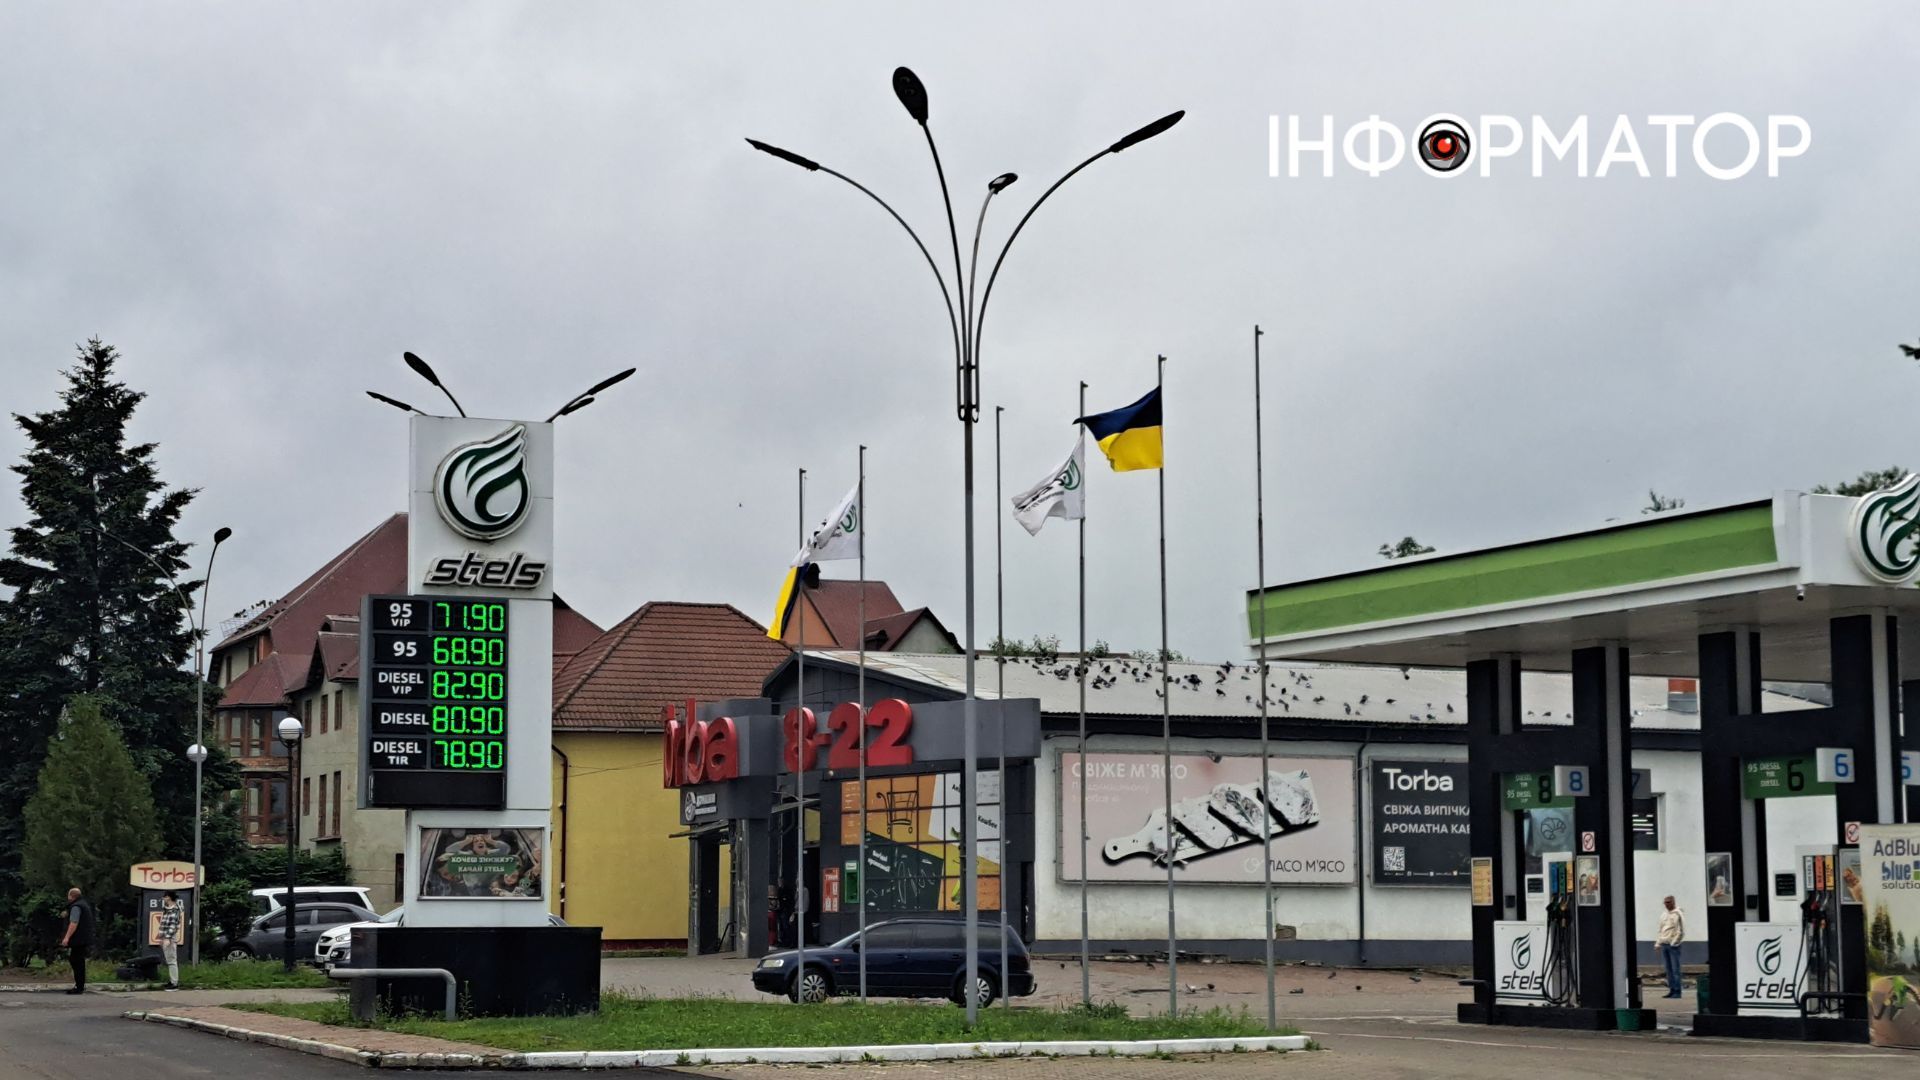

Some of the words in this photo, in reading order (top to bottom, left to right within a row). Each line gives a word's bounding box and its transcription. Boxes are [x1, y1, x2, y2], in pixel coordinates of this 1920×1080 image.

[426, 553, 548, 588] stels
[389, 603, 412, 617] 95
[435, 603, 505, 631] 71.90
[391, 618, 411, 627] VIP
[393, 642, 417, 656] 95
[433, 637, 504, 666] 68.90
[378, 672, 424, 684] DIESEL
[432, 671, 504, 700] 82.90
[392, 686, 412, 694] VIP
[380, 712, 429, 725] DIESEL
[432, 706, 503, 734] 80.90
[784, 699, 913, 773] 8-22
[373, 741, 422, 754] DIESEL
[435, 740, 503, 768] 78.90
[388, 756, 408, 765] TIR
[1835, 753, 1849, 777] 6
[1071, 762, 1126, 779] СВІЖЕ
[1382, 768, 1454, 791] Torba
[1787, 759, 1804, 791] 6
[1538, 775, 1552, 803] 8
[1569, 771, 1584, 792] 8
[1384, 805, 1421, 815] СВІЖА
[1384, 823, 1449, 834] АРОМАТНА
[1873, 838, 1920, 856] AdBlu
[137, 867, 196, 884] Torba
[1306, 859, 1345, 873] М'ЯСО
[1882, 860, 1912, 880] blue
[1882, 881, 1920, 889] solutio
[1501, 970, 1543, 991] stels
[1744, 977, 1797, 999] stels
